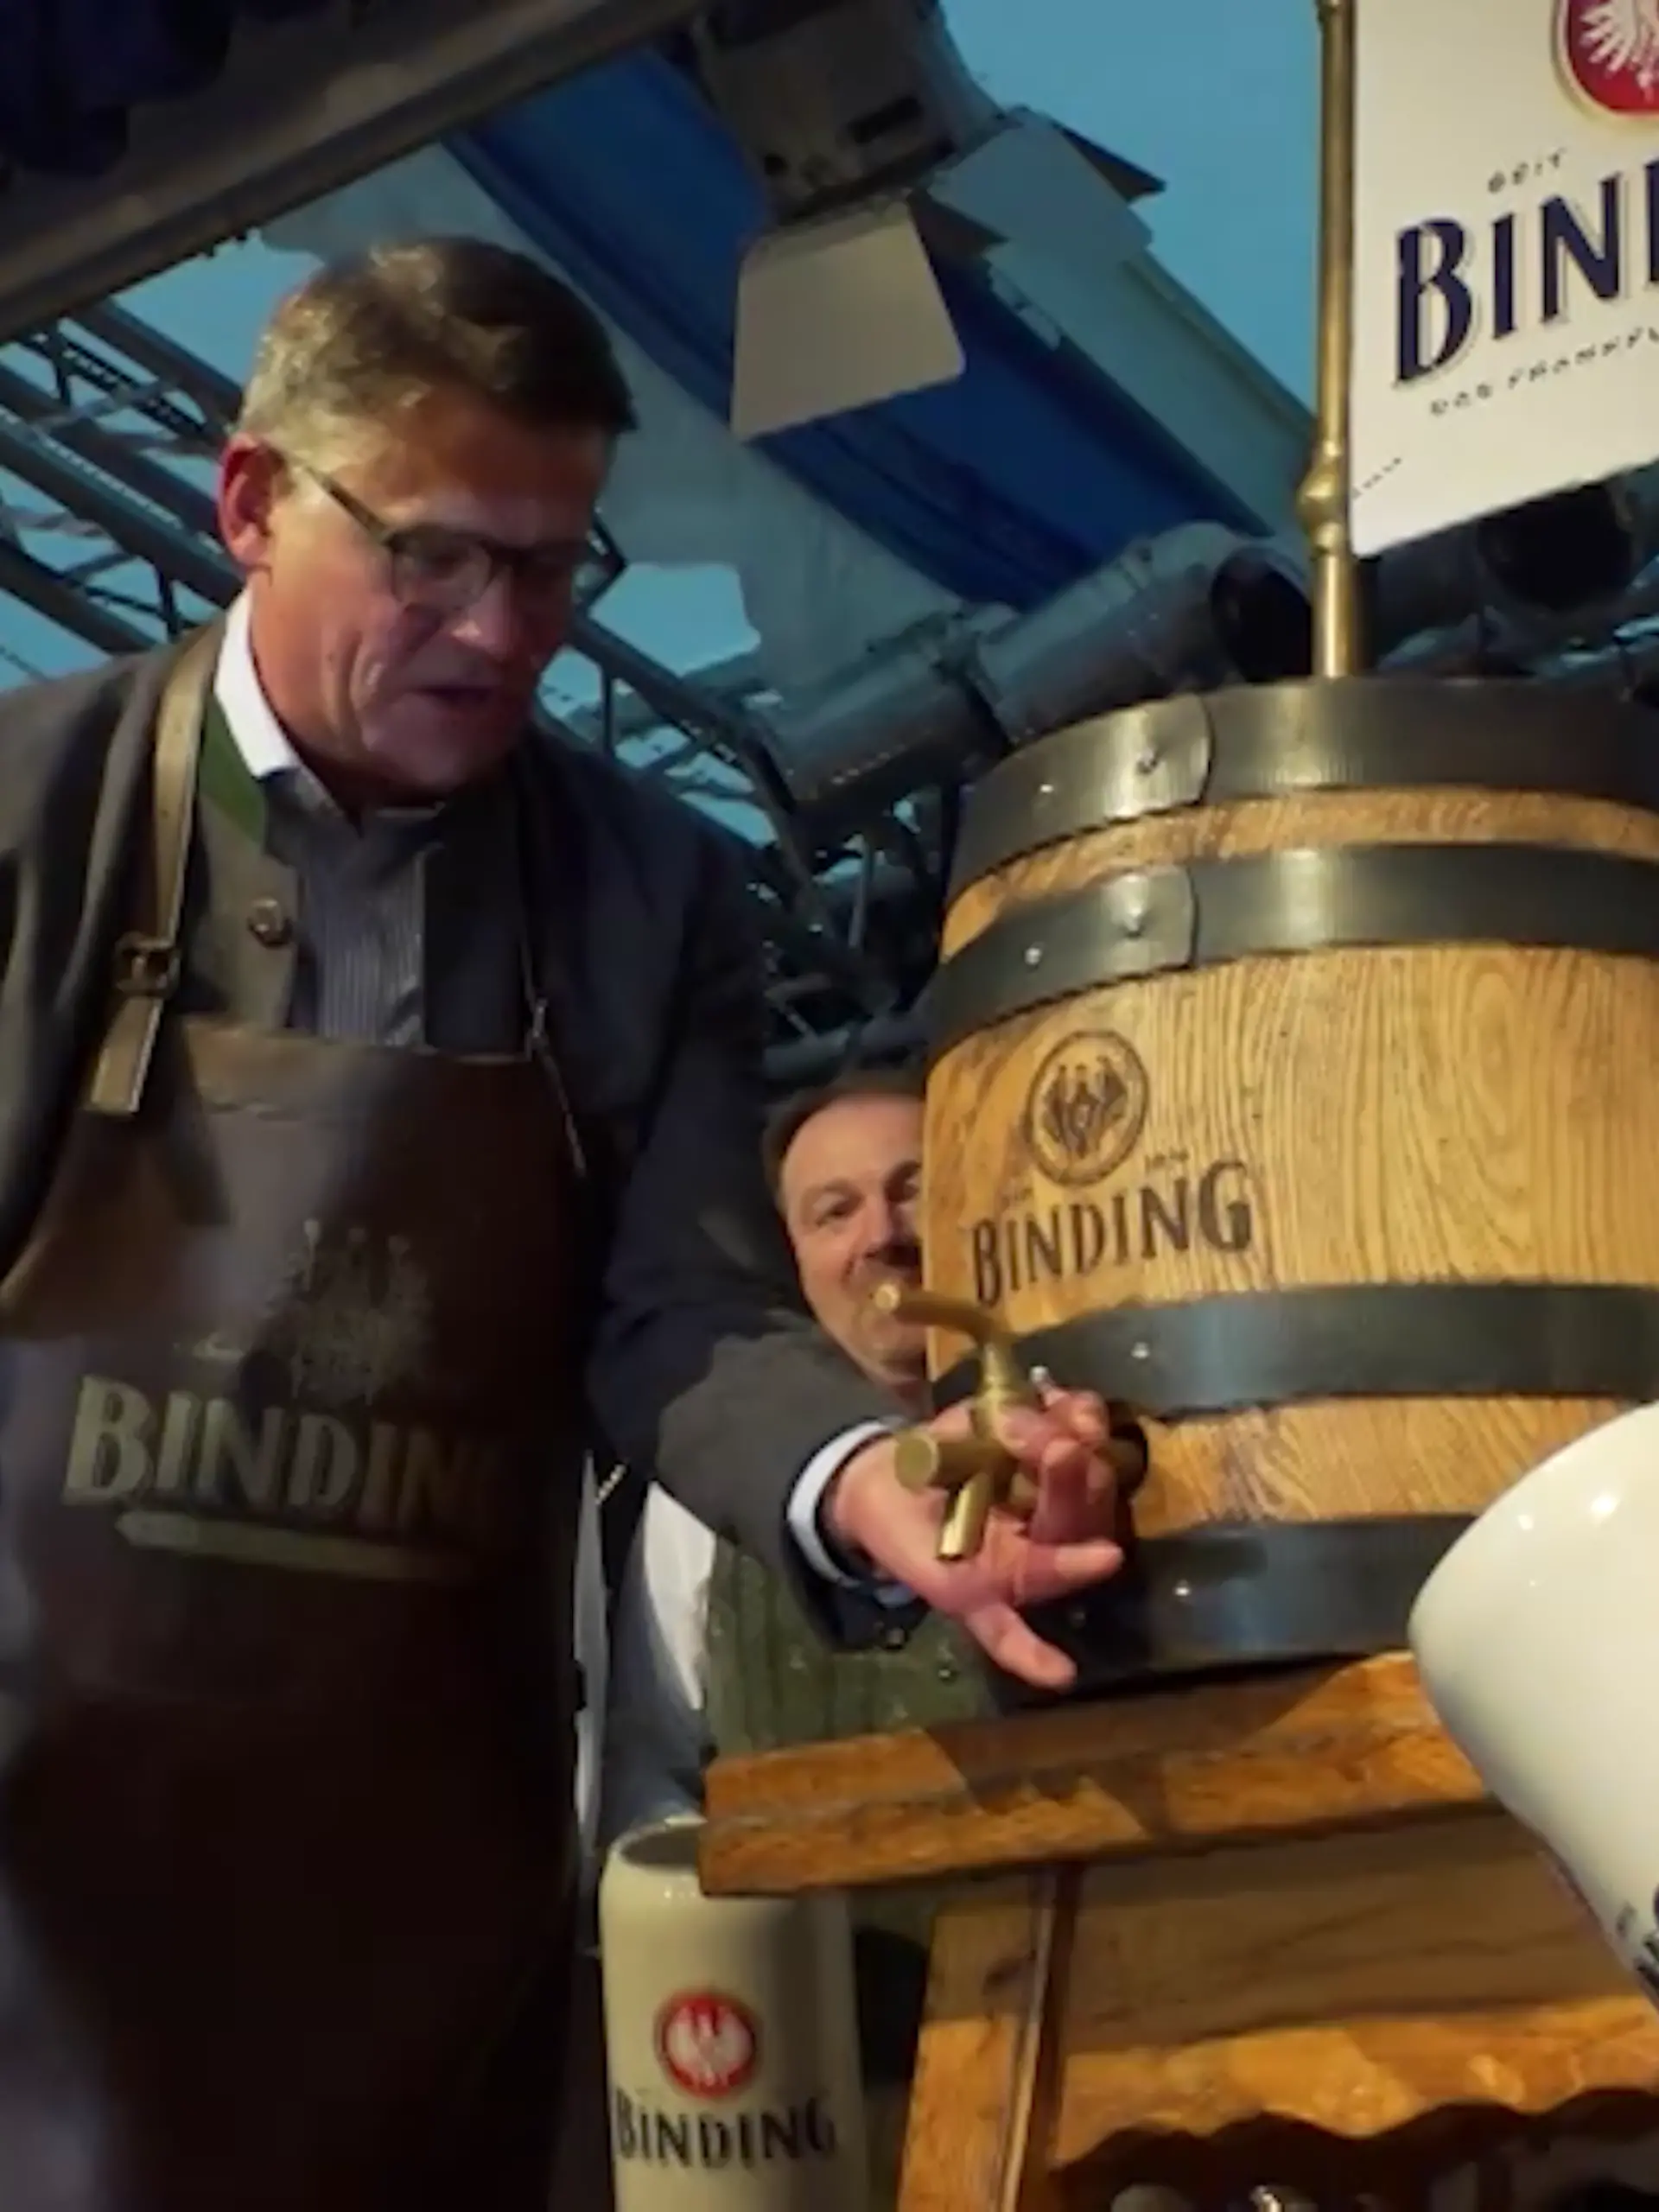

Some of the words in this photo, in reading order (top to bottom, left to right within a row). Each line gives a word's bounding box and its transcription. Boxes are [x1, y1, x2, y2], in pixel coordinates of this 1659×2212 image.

[1394, 156, 1659, 385] BIN
[971, 1159, 1251, 1308] BINDING
[60, 1373, 503, 1533] BINDIN
[616, 2088, 836, 2169] BINDING
